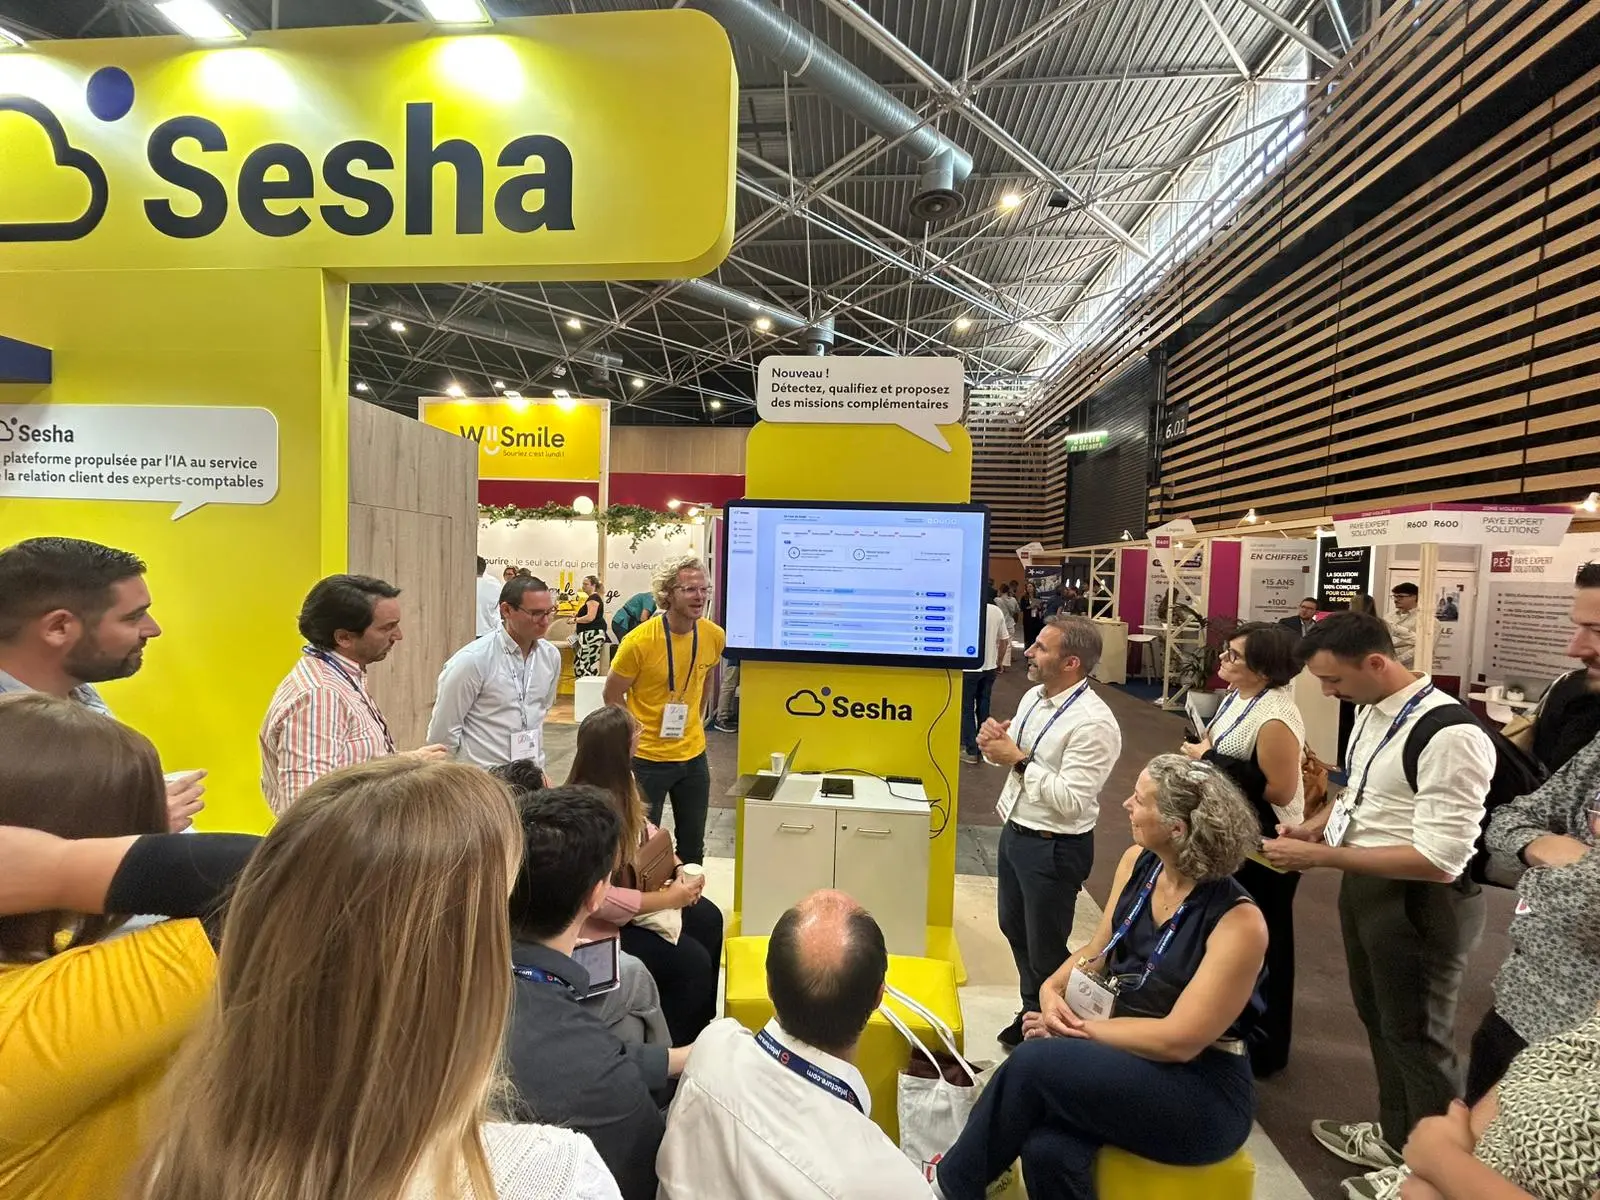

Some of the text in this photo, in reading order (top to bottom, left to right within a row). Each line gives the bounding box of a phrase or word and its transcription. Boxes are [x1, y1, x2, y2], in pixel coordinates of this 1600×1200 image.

[144, 102, 575, 239] Sesha
[772, 368, 822, 378] Nouveau
[771, 383, 950, 397] Détectez, qualifiez et proposez
[771, 398, 949, 411] des missions complémentaires
[18, 424, 75, 443] Sesha
[1165, 419, 1185, 439] 6.01
[3, 451, 258, 469] plateforme propulsée par l’IA au service
[4, 469, 264, 490] la relation client des experts-comptables
[1365, 520, 1389, 528] EXPERT
[1434, 520, 1459, 528] R600
[1508, 518, 1544, 526] EXPERT
[1351, 528, 1387, 537] SOLUTIONS
[1485, 526, 1540, 534] SOLUTIONS
[544, 559, 563, 567] actif
[566, 560, 578, 568] qui
[608, 561, 619, 569] de
[832, 696, 912, 721] Sesha
